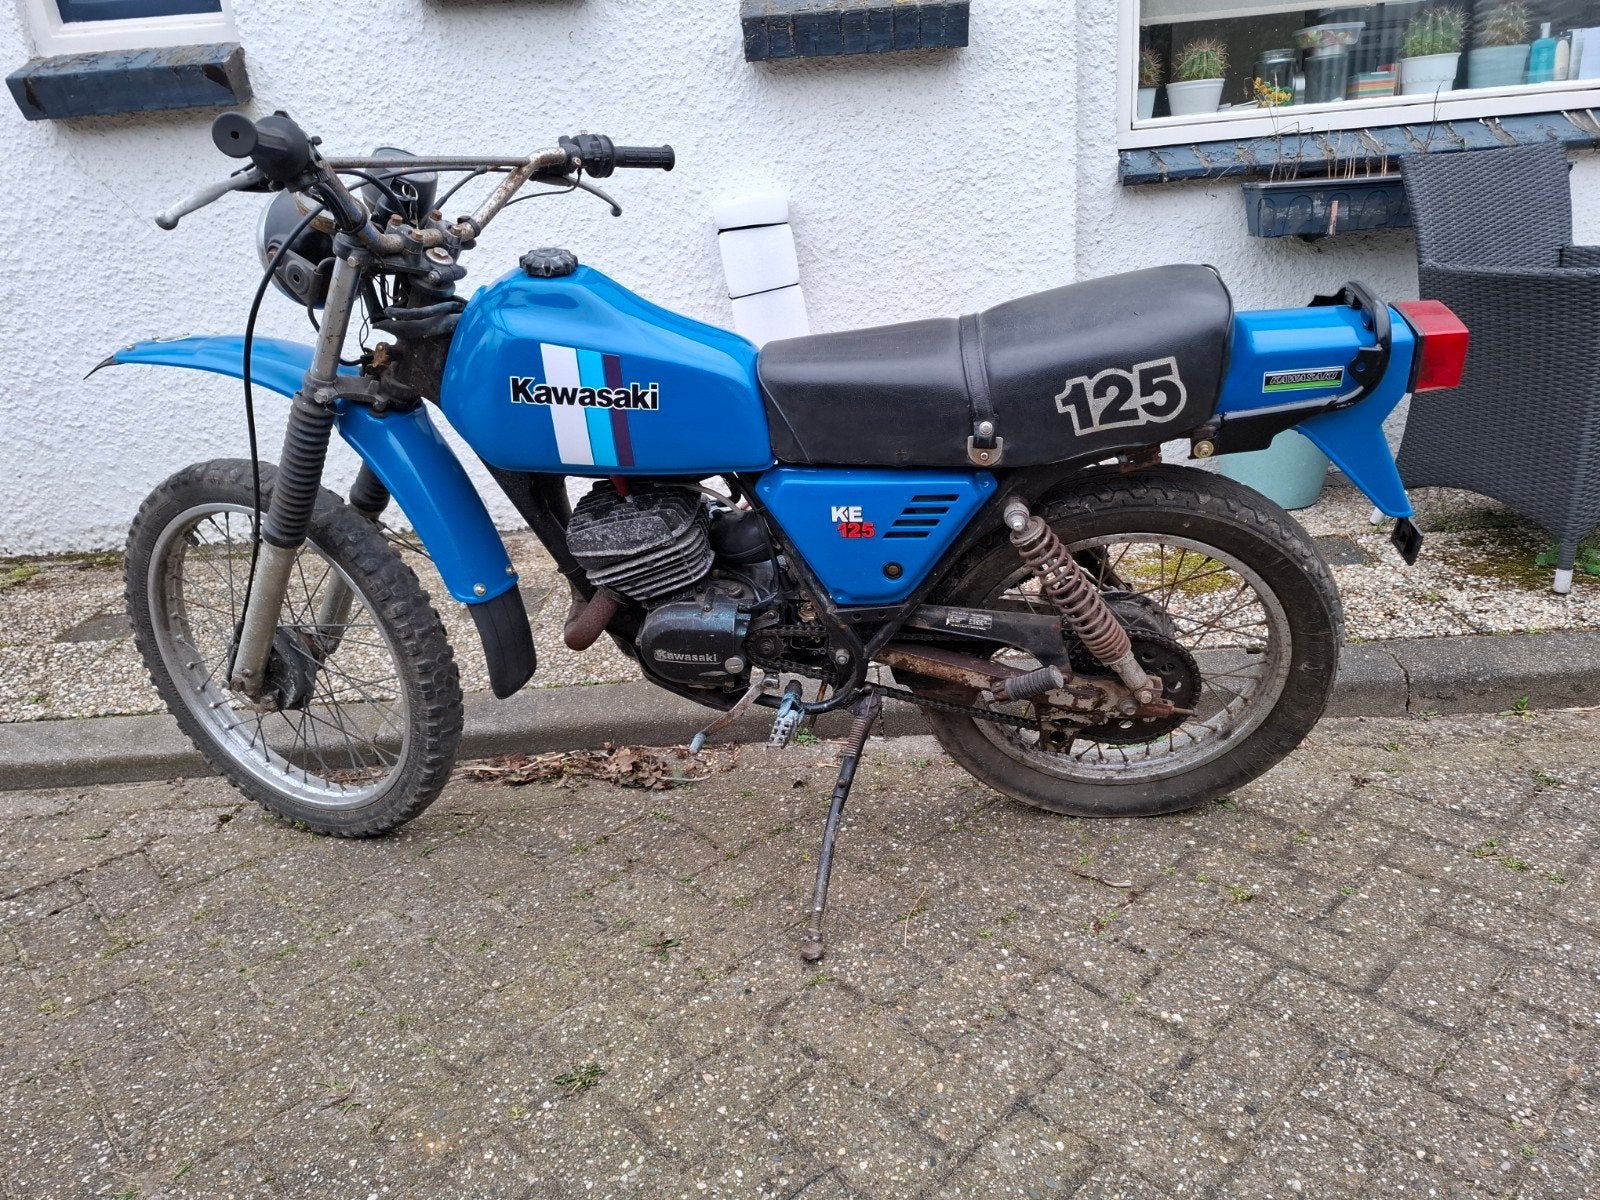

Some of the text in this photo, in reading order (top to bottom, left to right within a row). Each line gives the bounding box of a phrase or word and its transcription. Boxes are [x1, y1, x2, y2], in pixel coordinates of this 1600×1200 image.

[1269, 371, 1339, 385] KAWASAKI
[510, 376, 659, 410] Kawasaki
[1055, 356, 1187, 436] 125
[831, 506, 863, 522] KE
[837, 522, 876, 538] 125
[654, 649, 717, 662] Kawasaki
